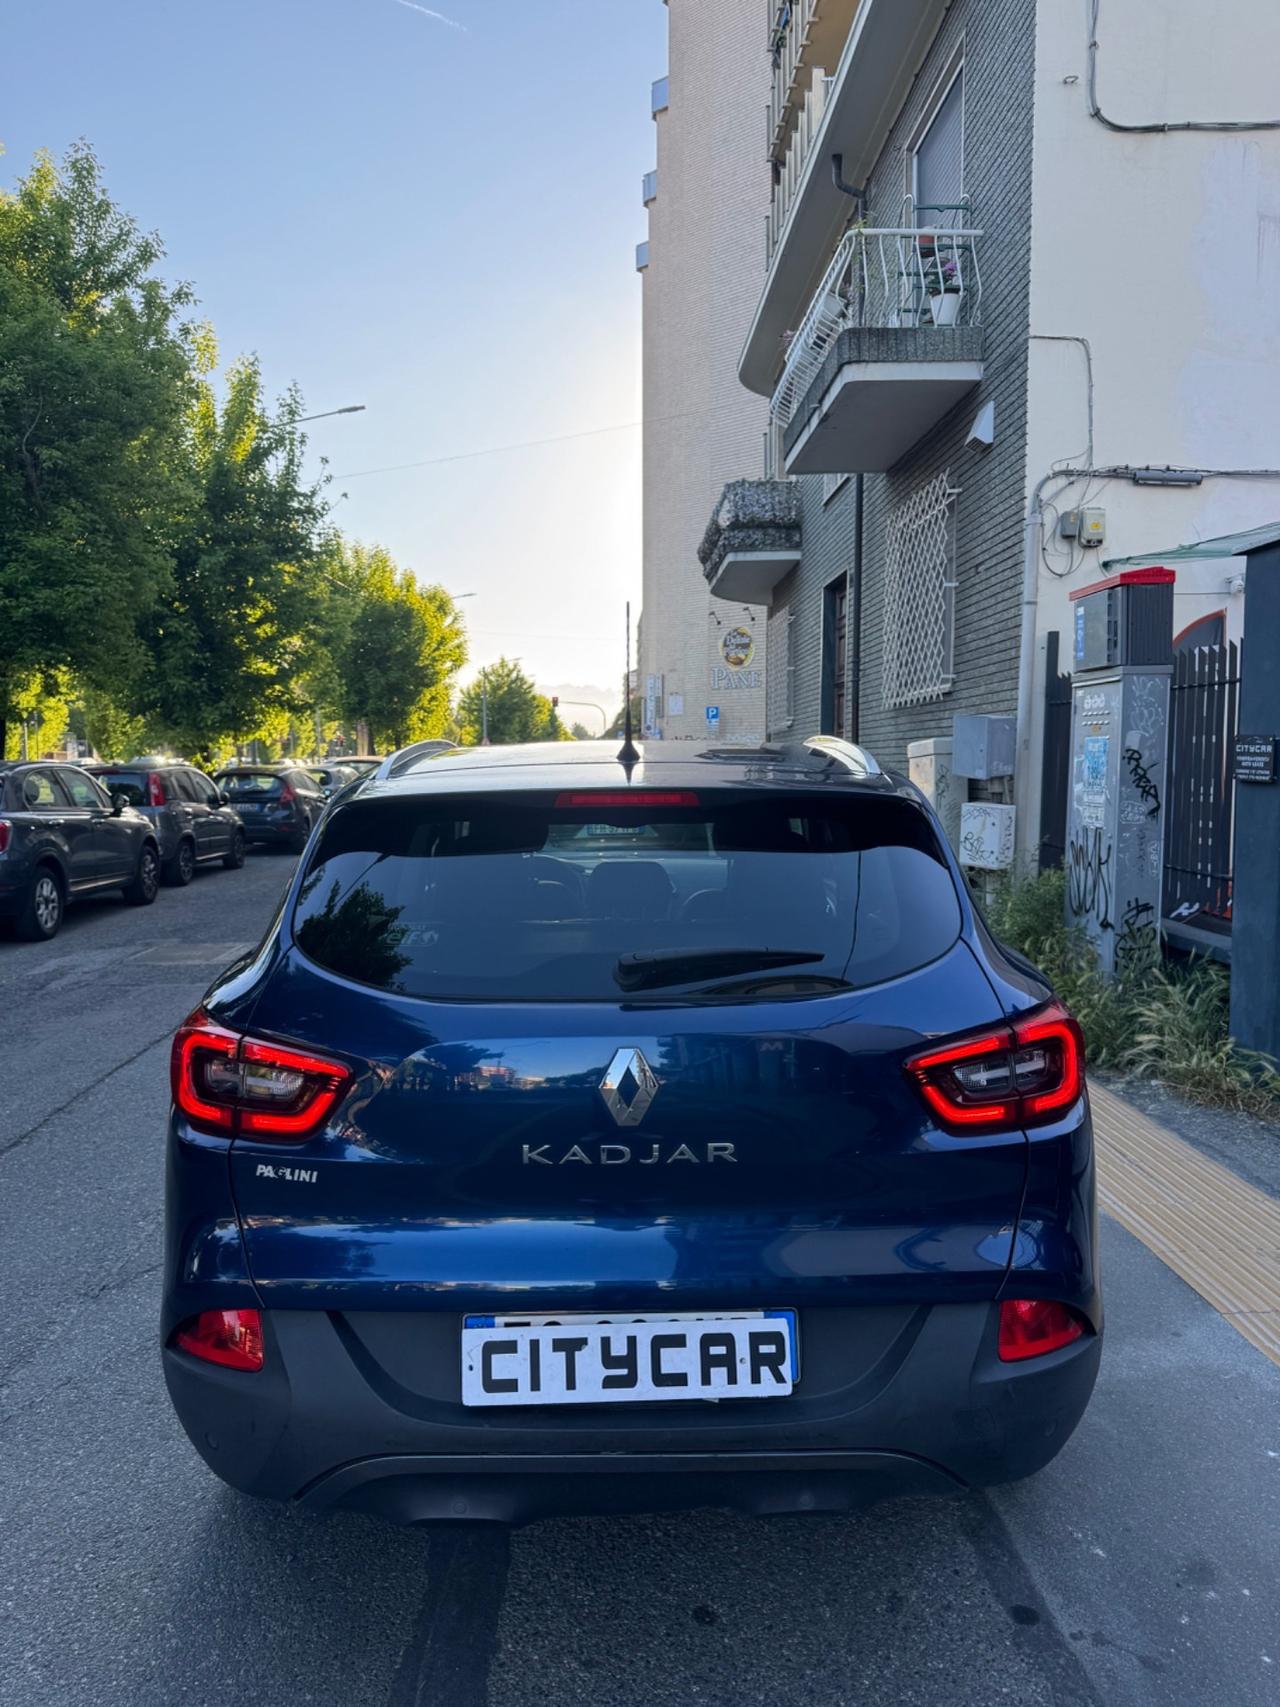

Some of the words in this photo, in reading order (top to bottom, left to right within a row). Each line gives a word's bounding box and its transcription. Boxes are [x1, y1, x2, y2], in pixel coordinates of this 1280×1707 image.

[708, 707, 717, 719] P
[1235, 744, 1273, 753] CITYCAR
[521, 1142, 738, 1165] KADJAR
[481, 1331, 788, 1394] CITYCAR
